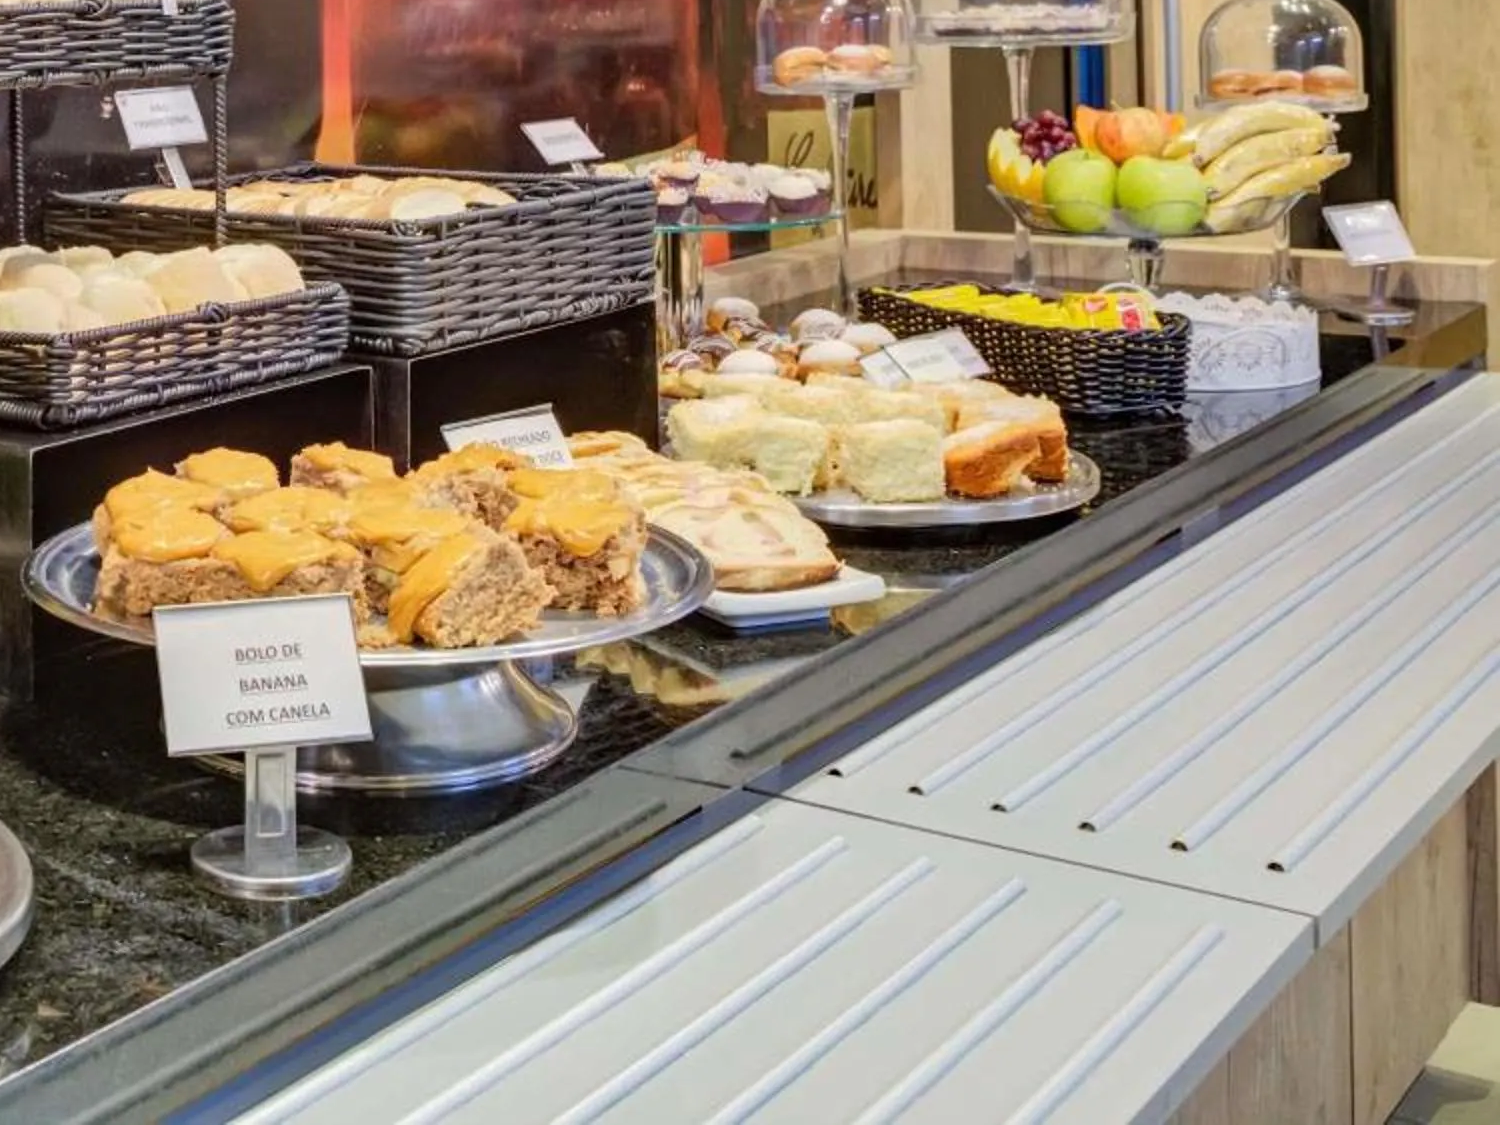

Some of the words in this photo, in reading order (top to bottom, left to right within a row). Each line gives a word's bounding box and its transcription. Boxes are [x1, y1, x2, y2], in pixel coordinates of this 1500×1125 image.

[235, 644, 277, 662] BOLO
[282, 642, 304, 658] DE
[239, 673, 309, 694] BANANA
[226, 709, 265, 727] COM
[269, 701, 331, 724] CANELA
